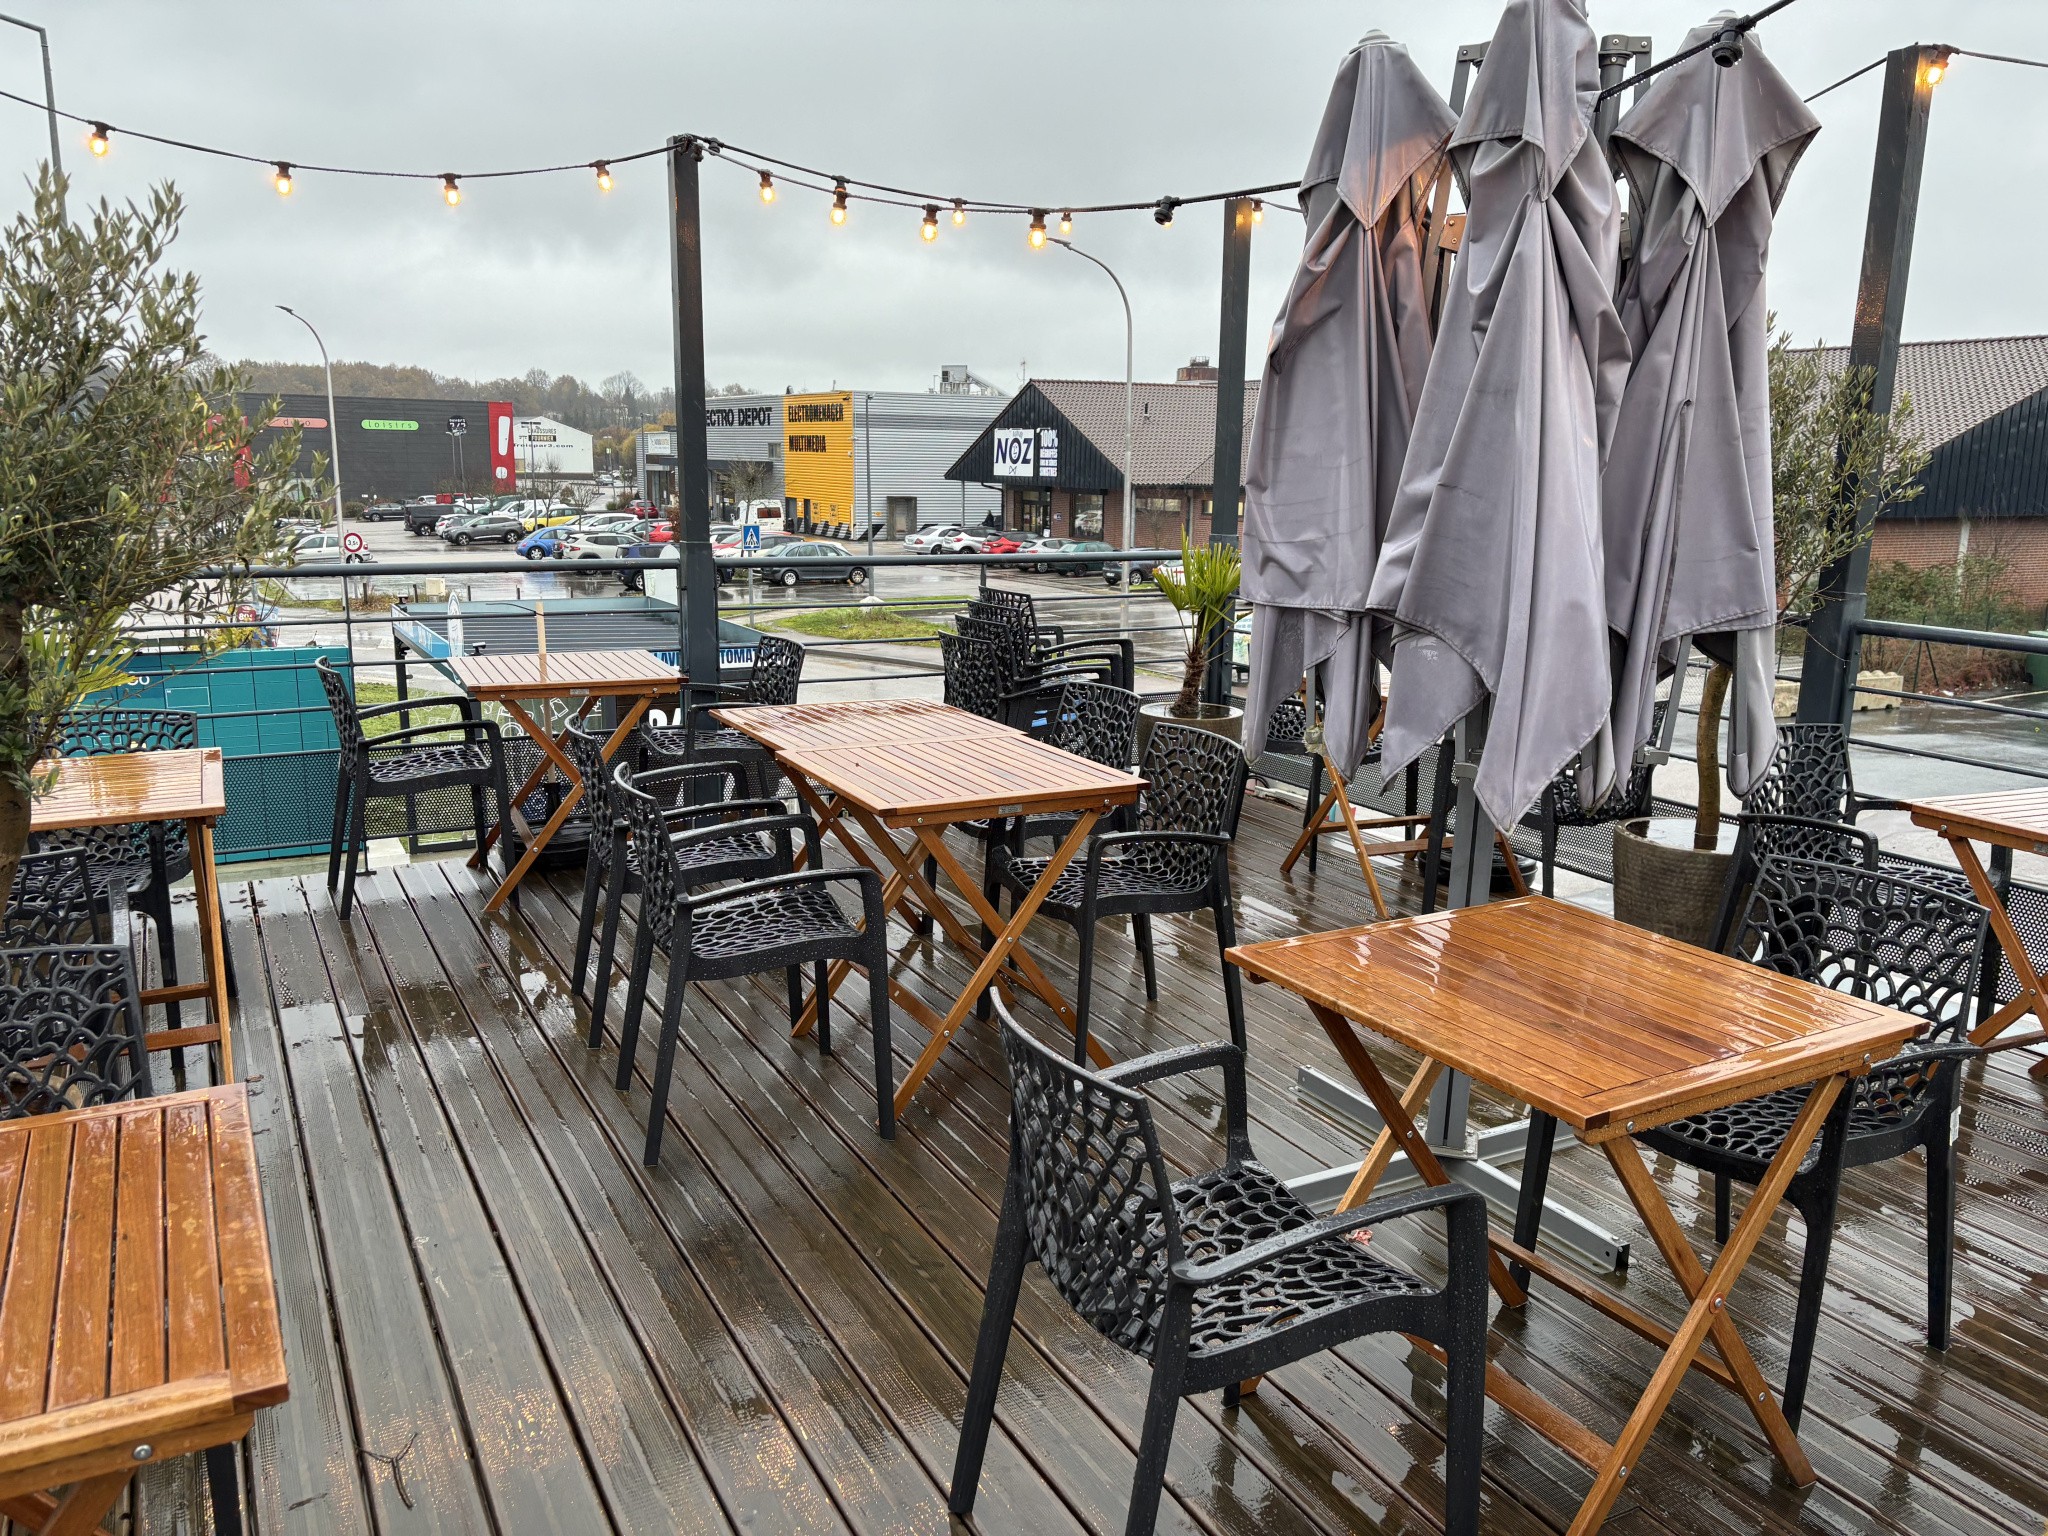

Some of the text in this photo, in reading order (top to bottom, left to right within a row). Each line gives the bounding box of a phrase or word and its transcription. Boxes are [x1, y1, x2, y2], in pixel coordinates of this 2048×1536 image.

[738, 407, 772, 426] DEPOT
[788, 403, 844, 422] ELECTROMENAGER
[368, 420, 412, 429] loisirs
[789, 435, 827, 453] MULTIMEDIA
[1040, 429, 1059, 448] 100%
[995, 437, 1034, 465] NOZ
